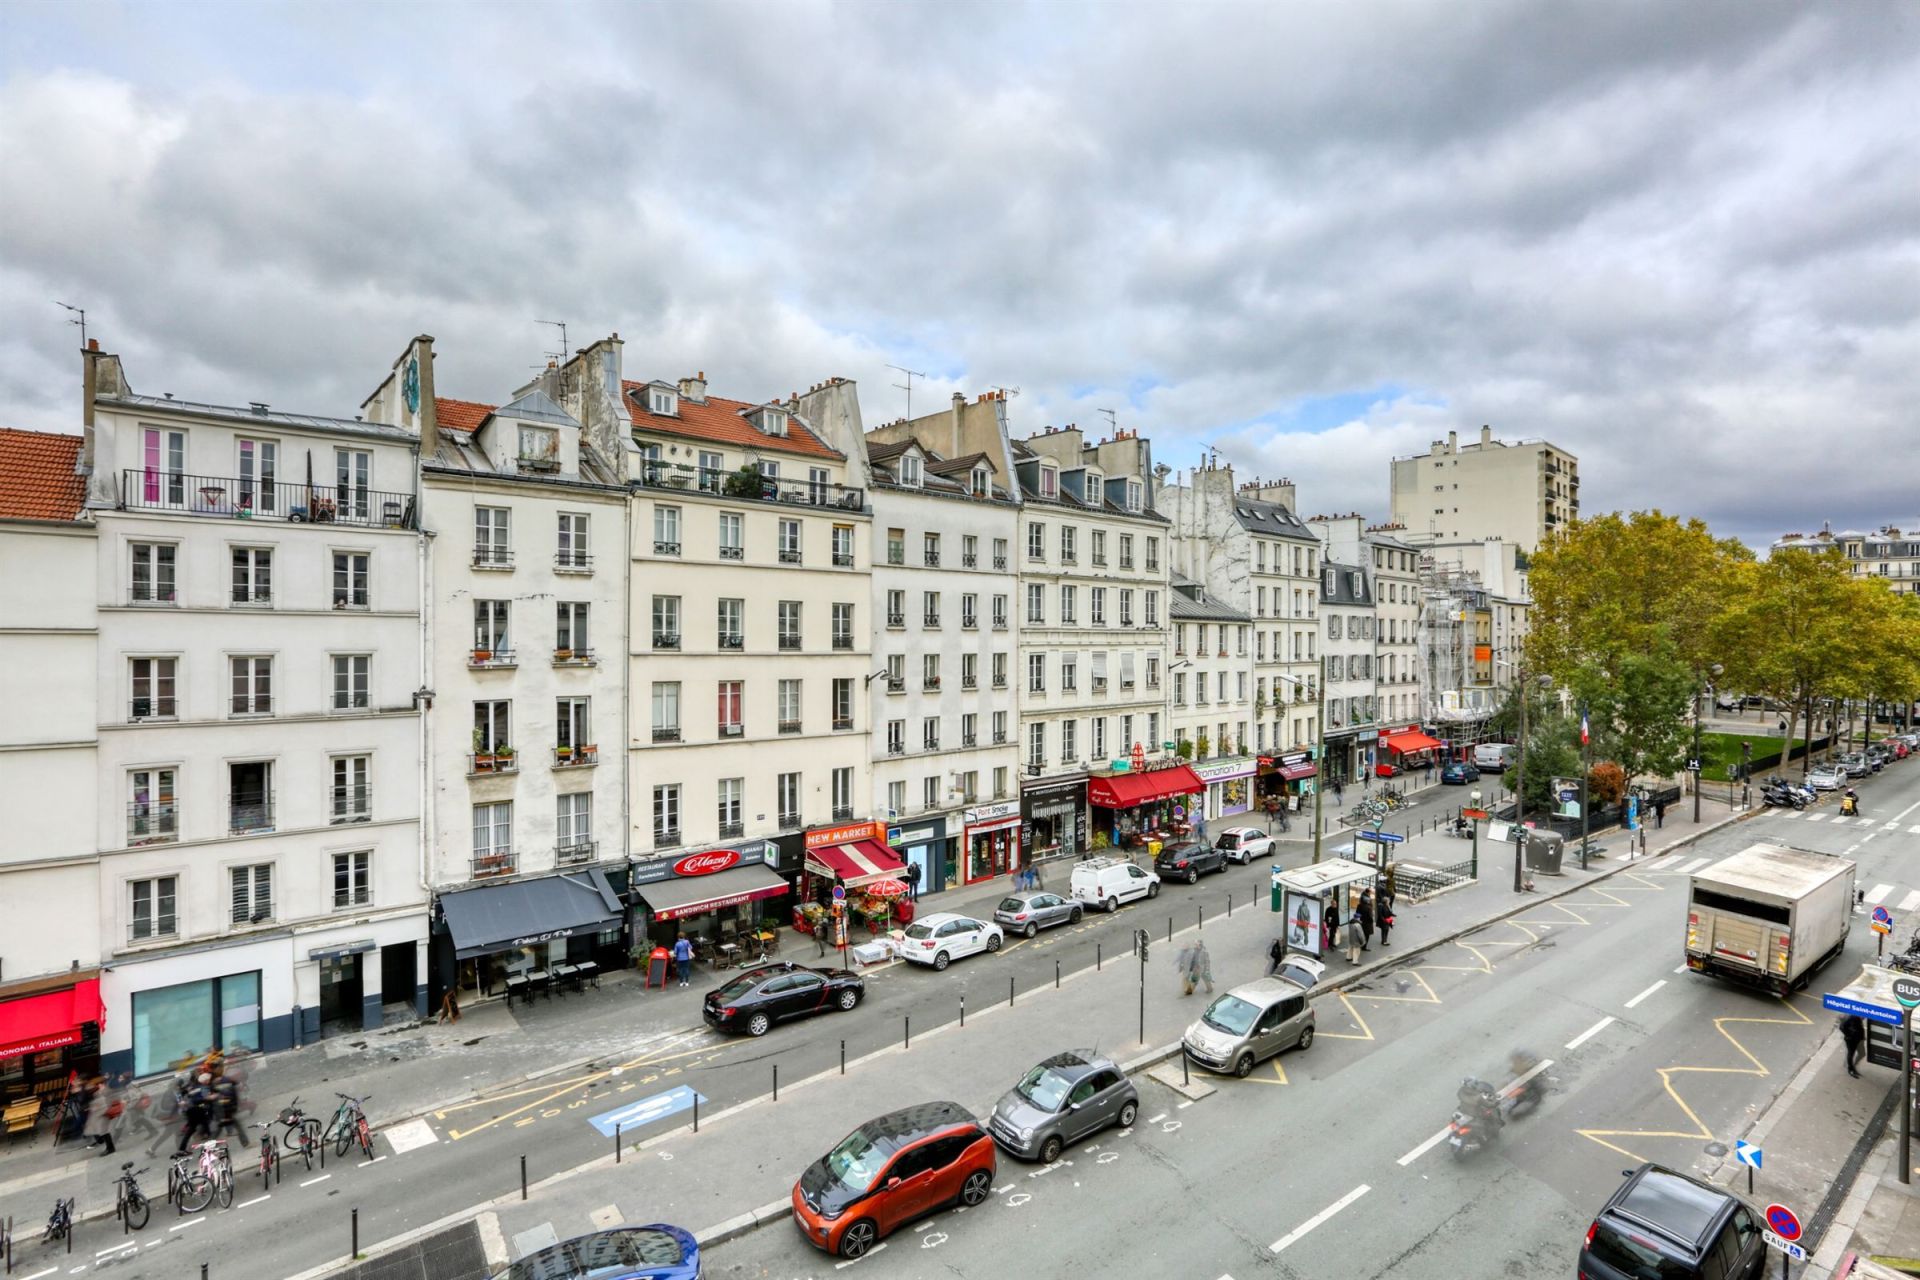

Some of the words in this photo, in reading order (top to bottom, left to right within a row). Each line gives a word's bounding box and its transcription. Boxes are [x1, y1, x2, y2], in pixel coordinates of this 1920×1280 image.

[807, 833, 829, 844] NEW
[832, 827, 873, 840] MARKET
[638, 862, 667, 872] RESTAURANT
[675, 904, 709, 917] SANDWICH
[709, 895, 750, 909] RESTAURANT
[1897, 984, 1920, 996] BUS
[1826, 998, 1851, 1010] Hôpital
[1852, 1003, 1897, 1020] Saint-Antoine
[39, 1036, 73, 1048] ITALIANA
[1764, 1233, 1788, 1249] SAUF
